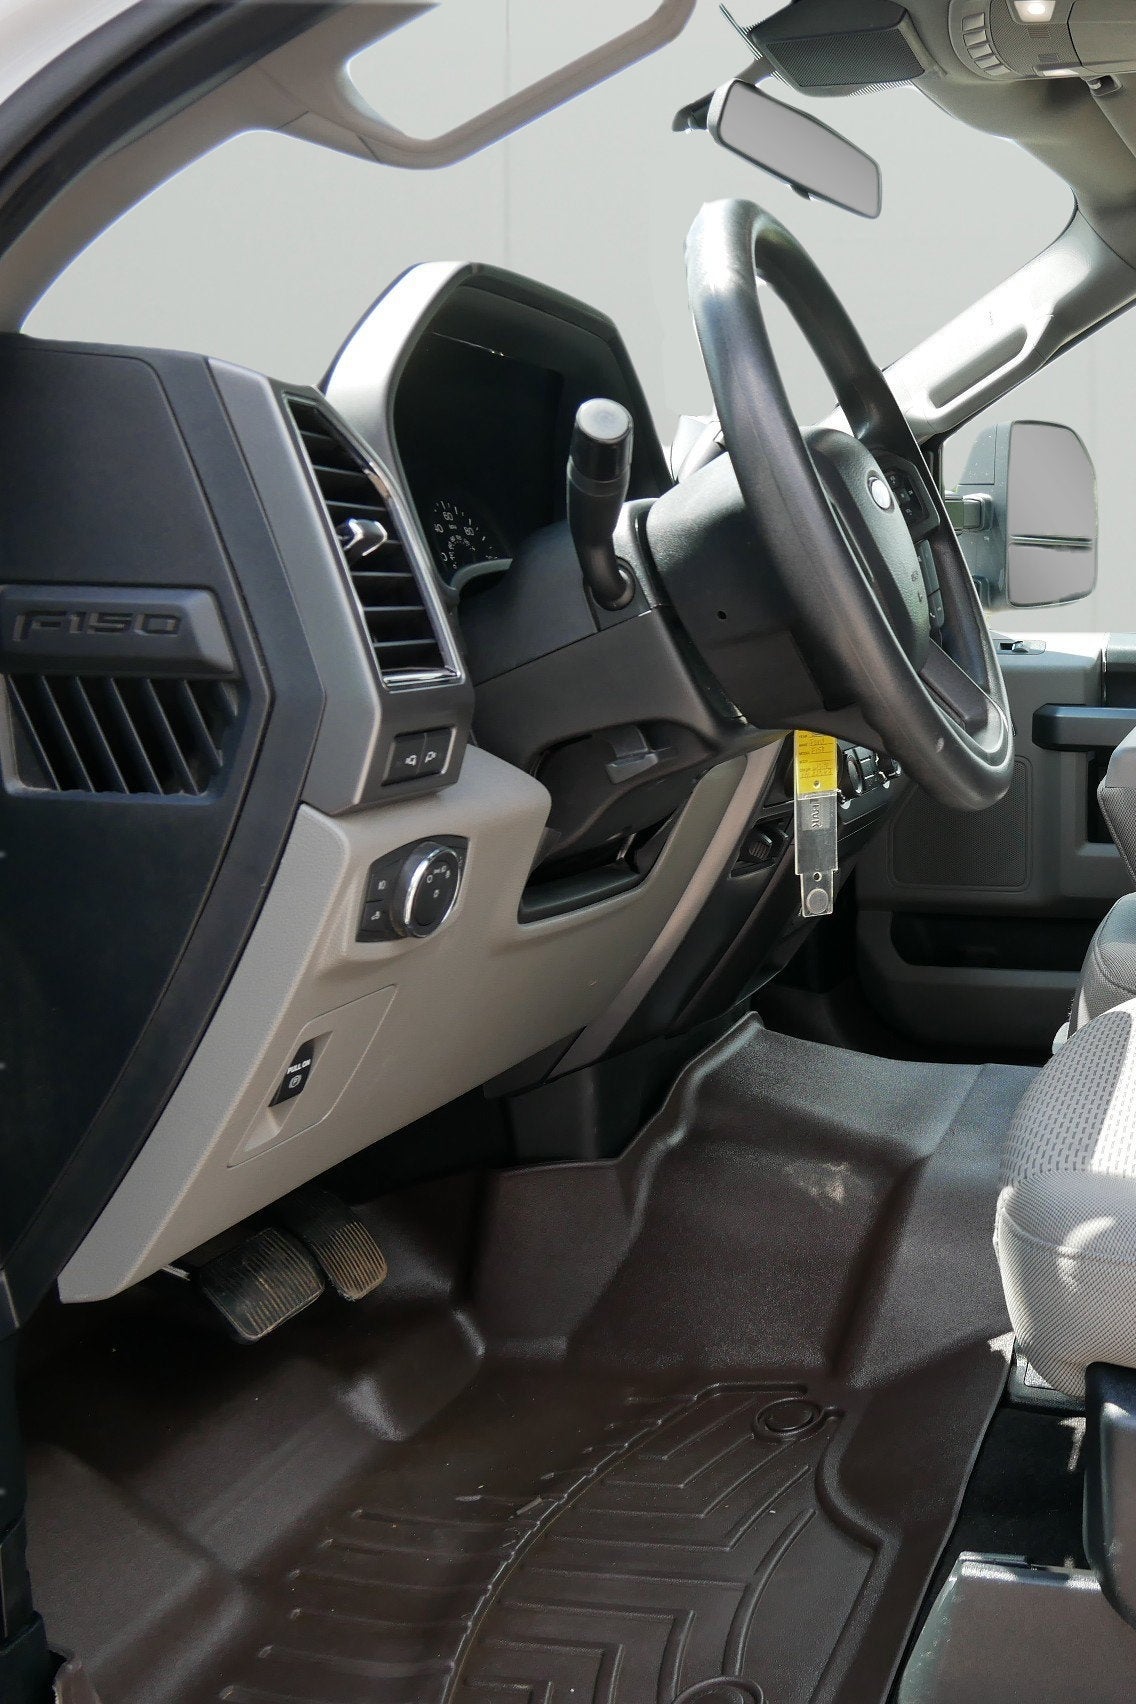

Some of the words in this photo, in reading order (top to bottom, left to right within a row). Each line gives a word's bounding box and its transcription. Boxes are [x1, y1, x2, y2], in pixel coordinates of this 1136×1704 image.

[11, 610, 182, 642] F150
[287, 1063, 301, 1075] PULL
[302, 1058, 311, 1068] ON
